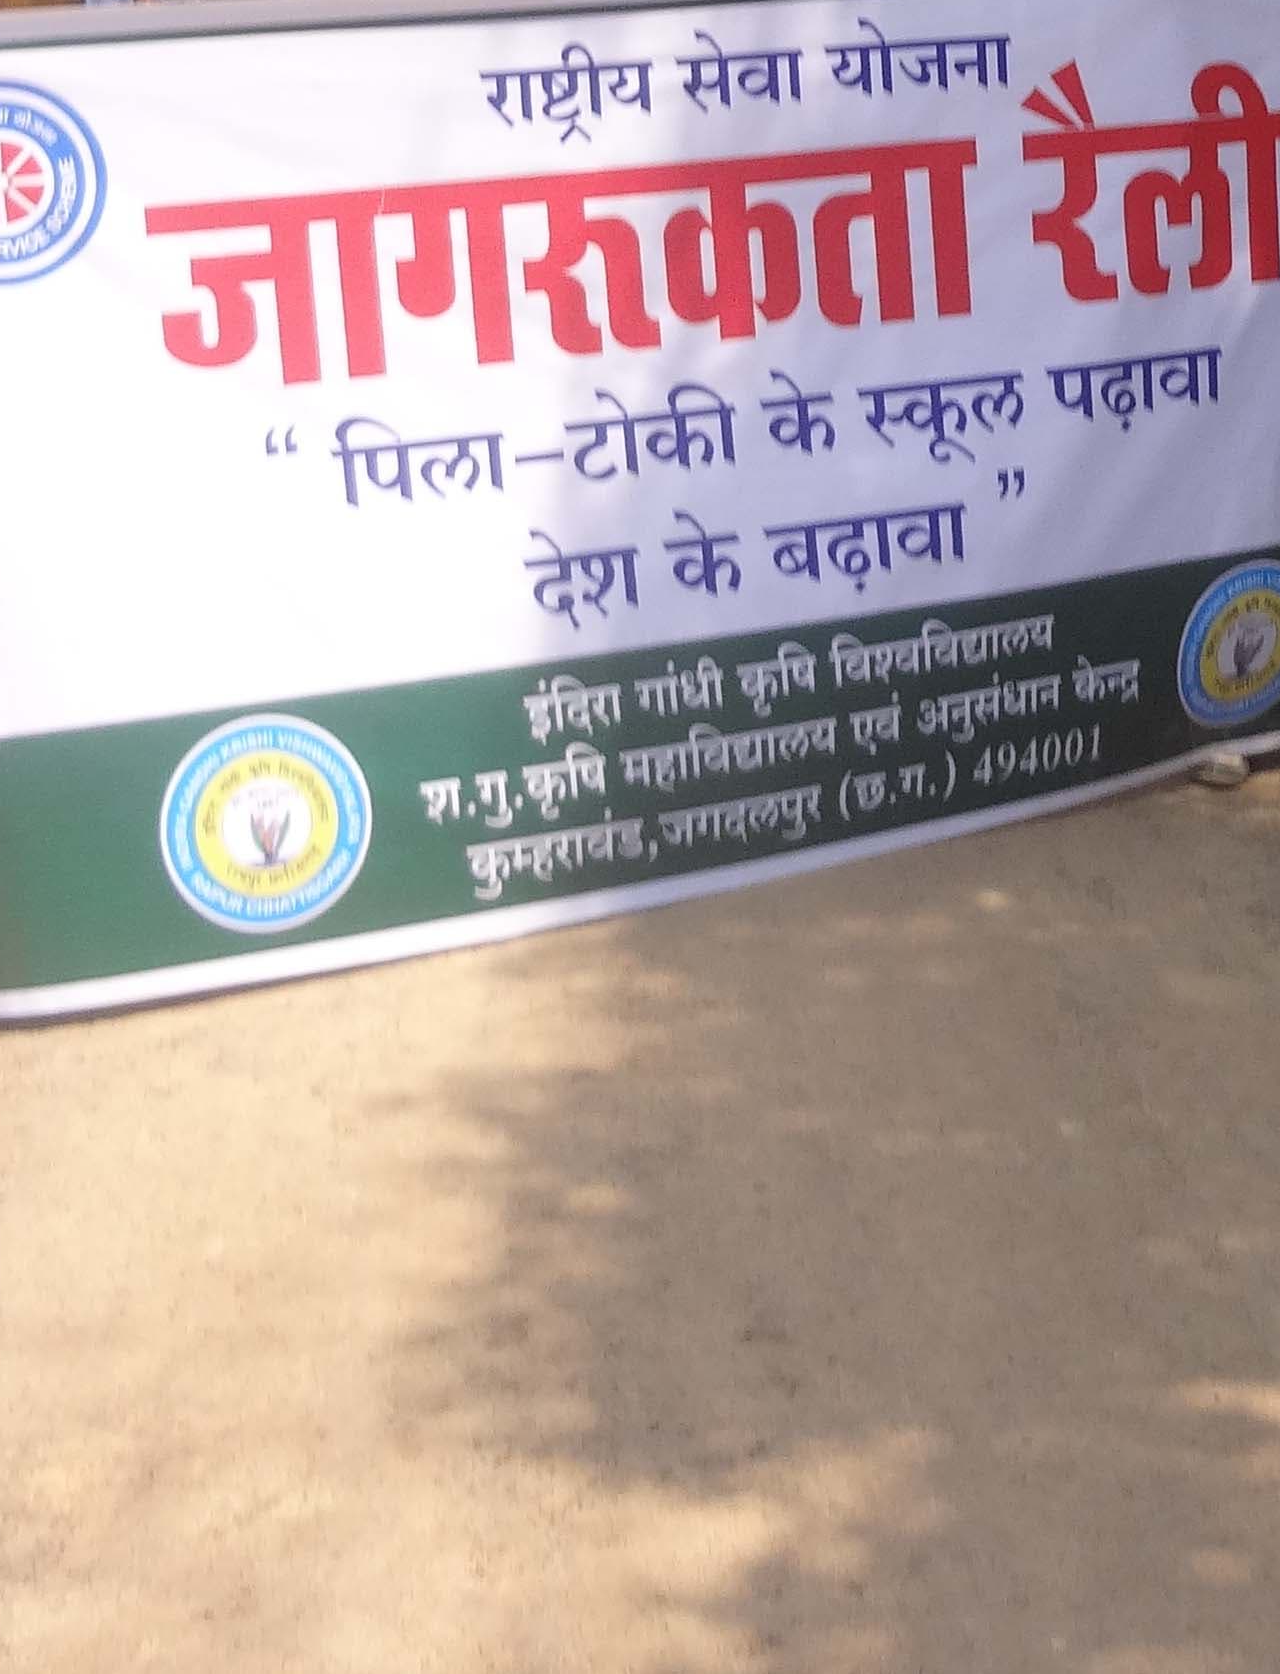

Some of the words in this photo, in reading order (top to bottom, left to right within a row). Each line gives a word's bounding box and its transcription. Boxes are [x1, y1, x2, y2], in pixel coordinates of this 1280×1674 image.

[478, 41, 654, 143] राष्ट्रीय
[674, 30, 804, 113] सेवा
[824, 16, 1012, 96] योजना
[144, 137, 978, 384] जागरूकता
[760, 370, 837, 457] के
[857, 371, 1025, 464] स्कूल
[1045, 346, 1223, 433] पढ़ावा
[523, 529, 639, 630] देश
[663, 510, 742, 596] के
[763, 500, 967, 598] बढ़ावा
[522, 675, 621, 746] इंदिरा
[633, 655, 723, 719] गांधी
[736, 641, 817, 718] कृषि
[828, 613, 1056, 688] विश्वविद्यालय
[619, 722, 837, 795] महाविद्यालय
[848, 689, 902, 756] एवं
[917, 671, 1063, 743] अनुसंधान
[1071, 654, 1141, 704] केन्द्र
[972, 723, 1101, 787] 494001
